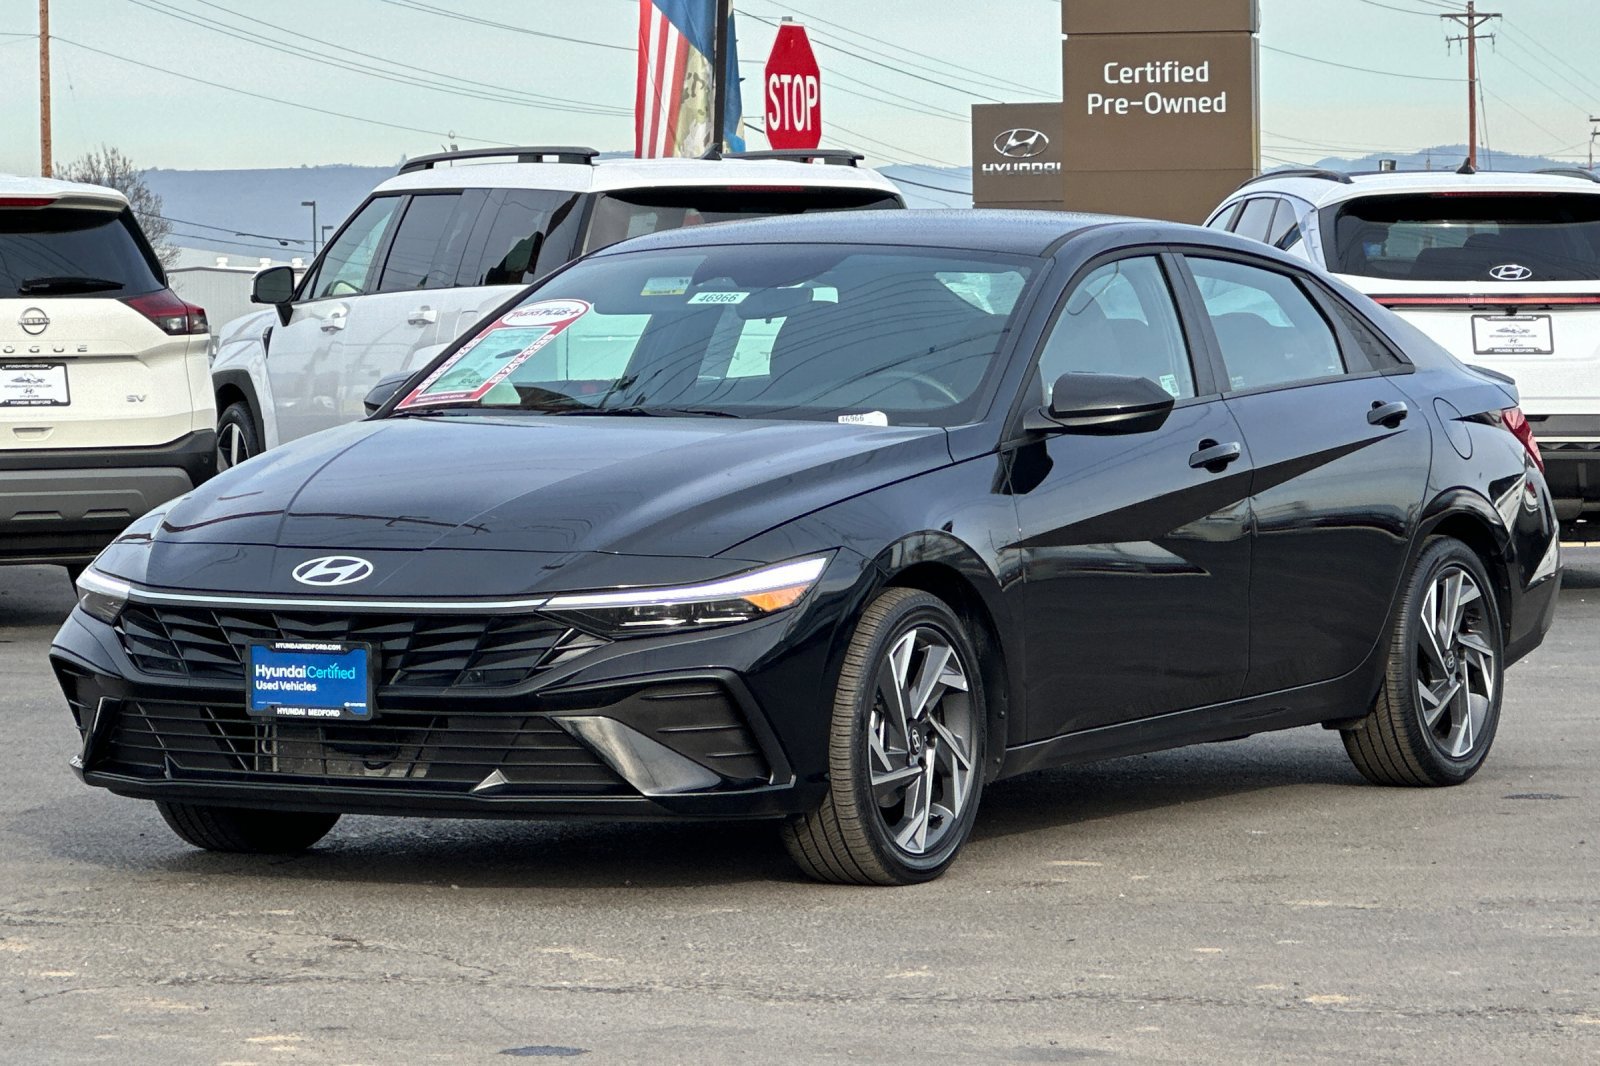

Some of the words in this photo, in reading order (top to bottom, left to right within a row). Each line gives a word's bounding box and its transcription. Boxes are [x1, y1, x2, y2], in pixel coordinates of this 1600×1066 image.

[1103, 60, 1209, 84] Certified
[768, 73, 818, 132] STOP
[1087, 91, 1227, 115] Pre-Owned
[982, 162, 1061, 175] HYUNDAI
[698, 293, 739, 302] 46966
[126, 394, 147, 403] SV
[275, 642, 342, 651] HYUNDAIMEDFORD.COM
[255, 664, 306, 679] Hyundai
[306, 663, 356, 680] Certified
[255, 680, 279, 691] Used
[279, 681, 317, 692] Vehicles
[276, 707, 305, 716] HYUNDAI
[307, 708, 341, 717] MEDFORD
